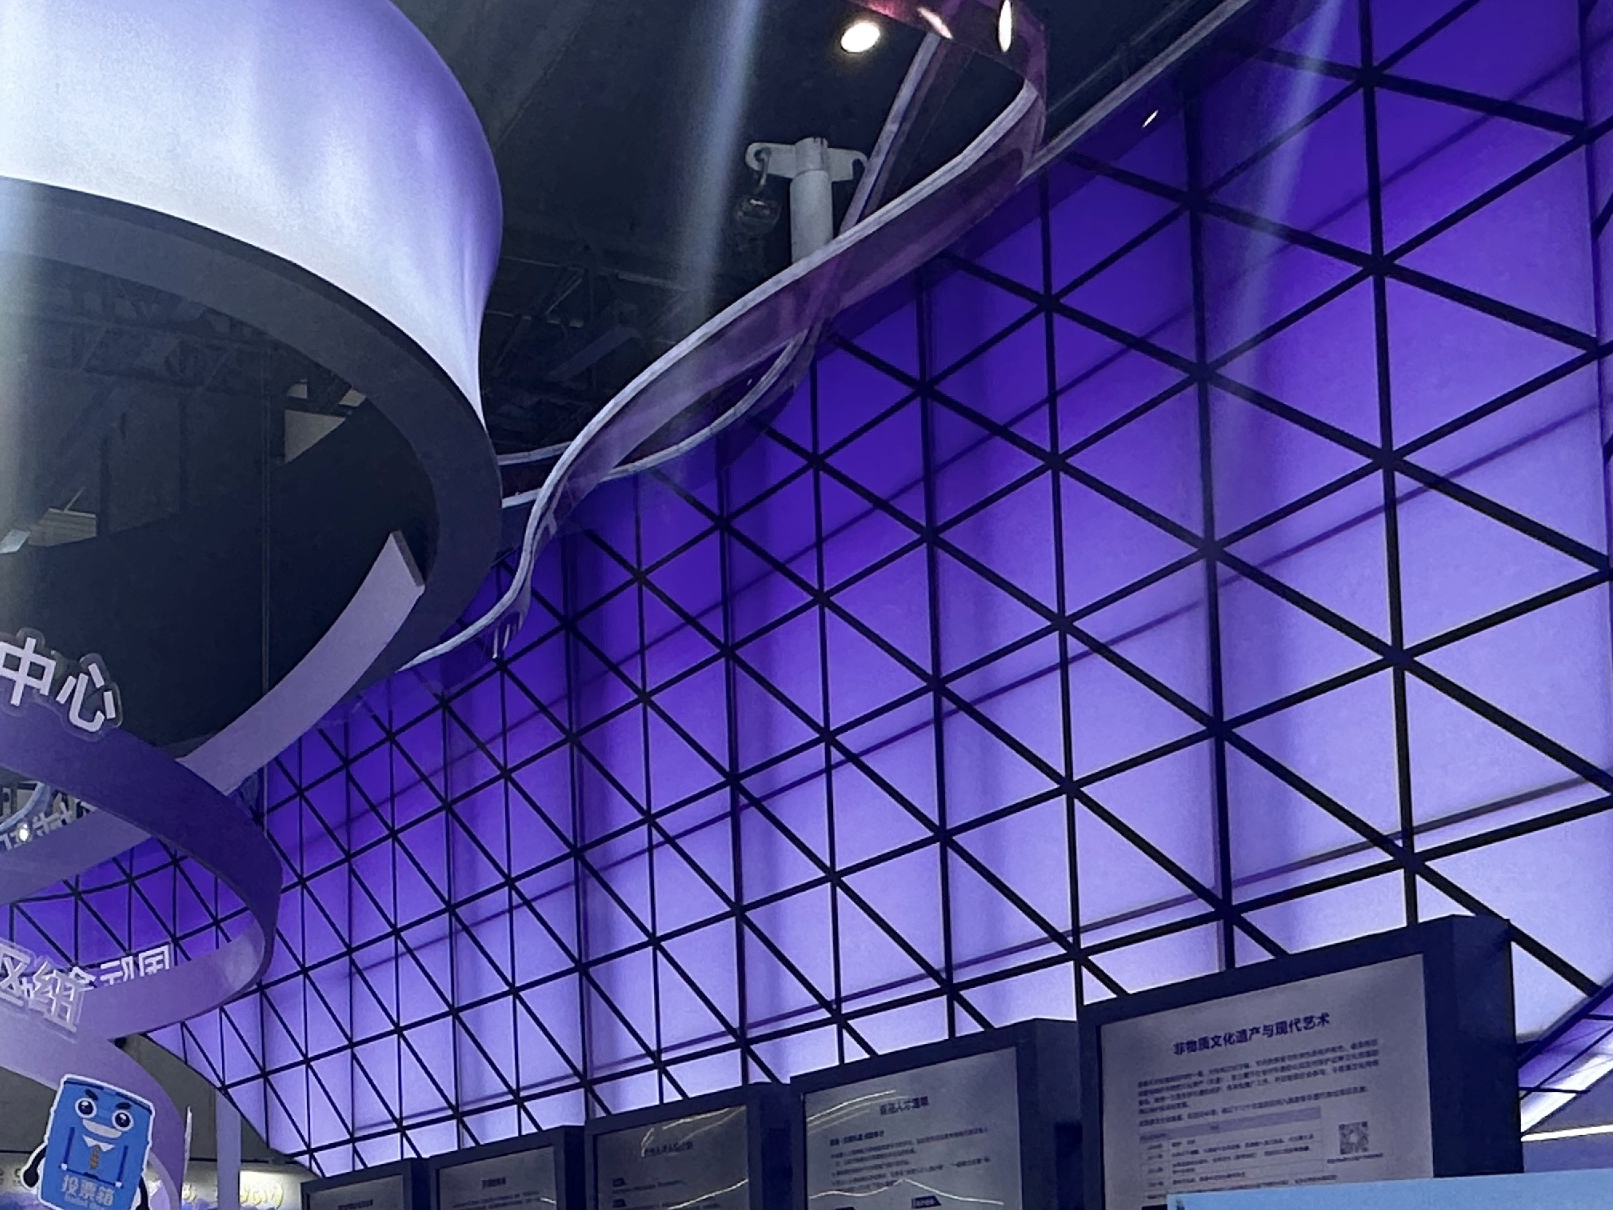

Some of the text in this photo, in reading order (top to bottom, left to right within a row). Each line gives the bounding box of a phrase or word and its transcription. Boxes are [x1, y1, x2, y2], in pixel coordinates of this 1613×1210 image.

[1173, 1012, 1330, 1055] 非物质文化遗产与现代艺术
[61, 1174, 116, 1206] 投票箱
